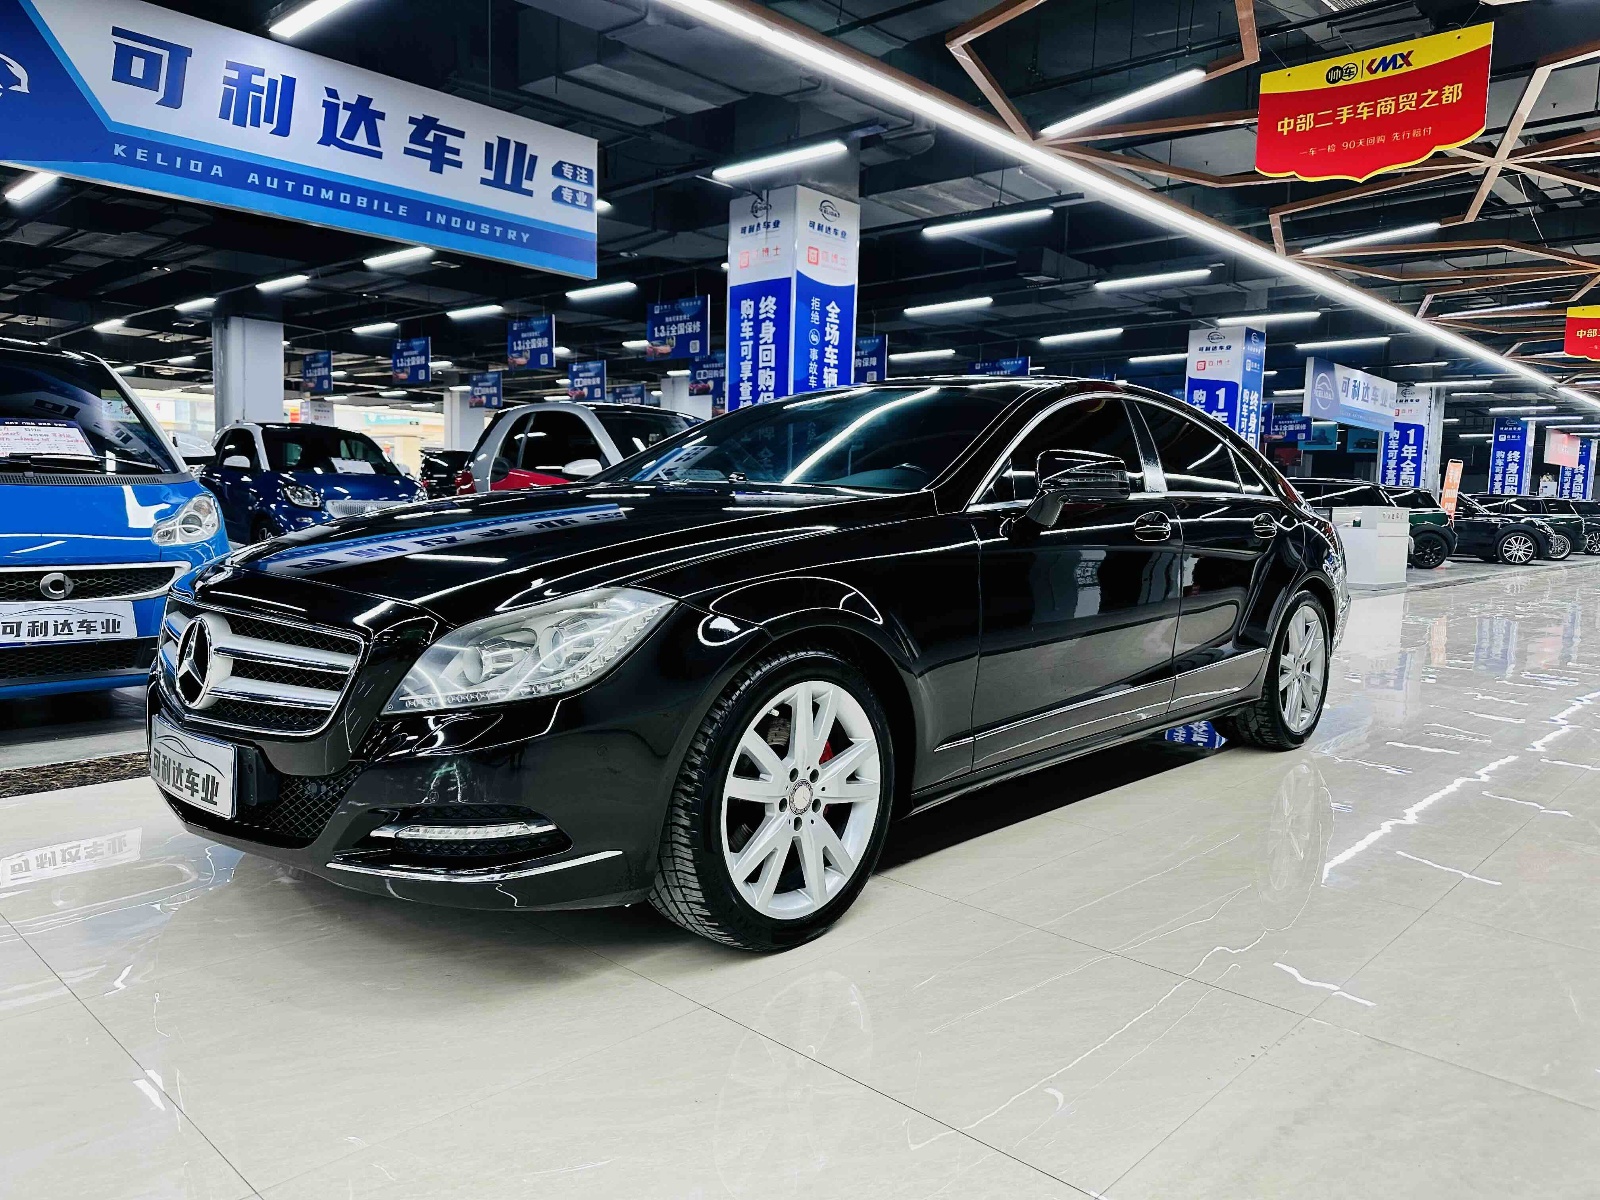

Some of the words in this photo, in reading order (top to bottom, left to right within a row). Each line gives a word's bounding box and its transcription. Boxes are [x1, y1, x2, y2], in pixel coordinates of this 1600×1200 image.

[110, 26, 539, 198] 可利达车业
[1277, 82, 1463, 136] 中部二手车商贸之都
[1342, 135, 1386, 151] 90天回购
[1392, 126, 1432, 141] 先行赔付
[562, 163, 589, 184] 专注
[113, 143, 223, 178] KELIDA
[247, 172, 408, 217] AUTOMOBILE
[425, 210, 530, 243] INDUSTRY
[560, 187, 588, 207] 专业
[808, 220, 847, 239] 可利达车业
[823, 300, 841, 388] 全场车辆
[1576, 328, 1600, 339] 中部
[808, 348, 819, 389] 事故车
[1341, 376, 1388, 408] 可利达车业
[0, 618, 121, 638] 可利达车业
[152, 747, 220, 806] 可利达车业
